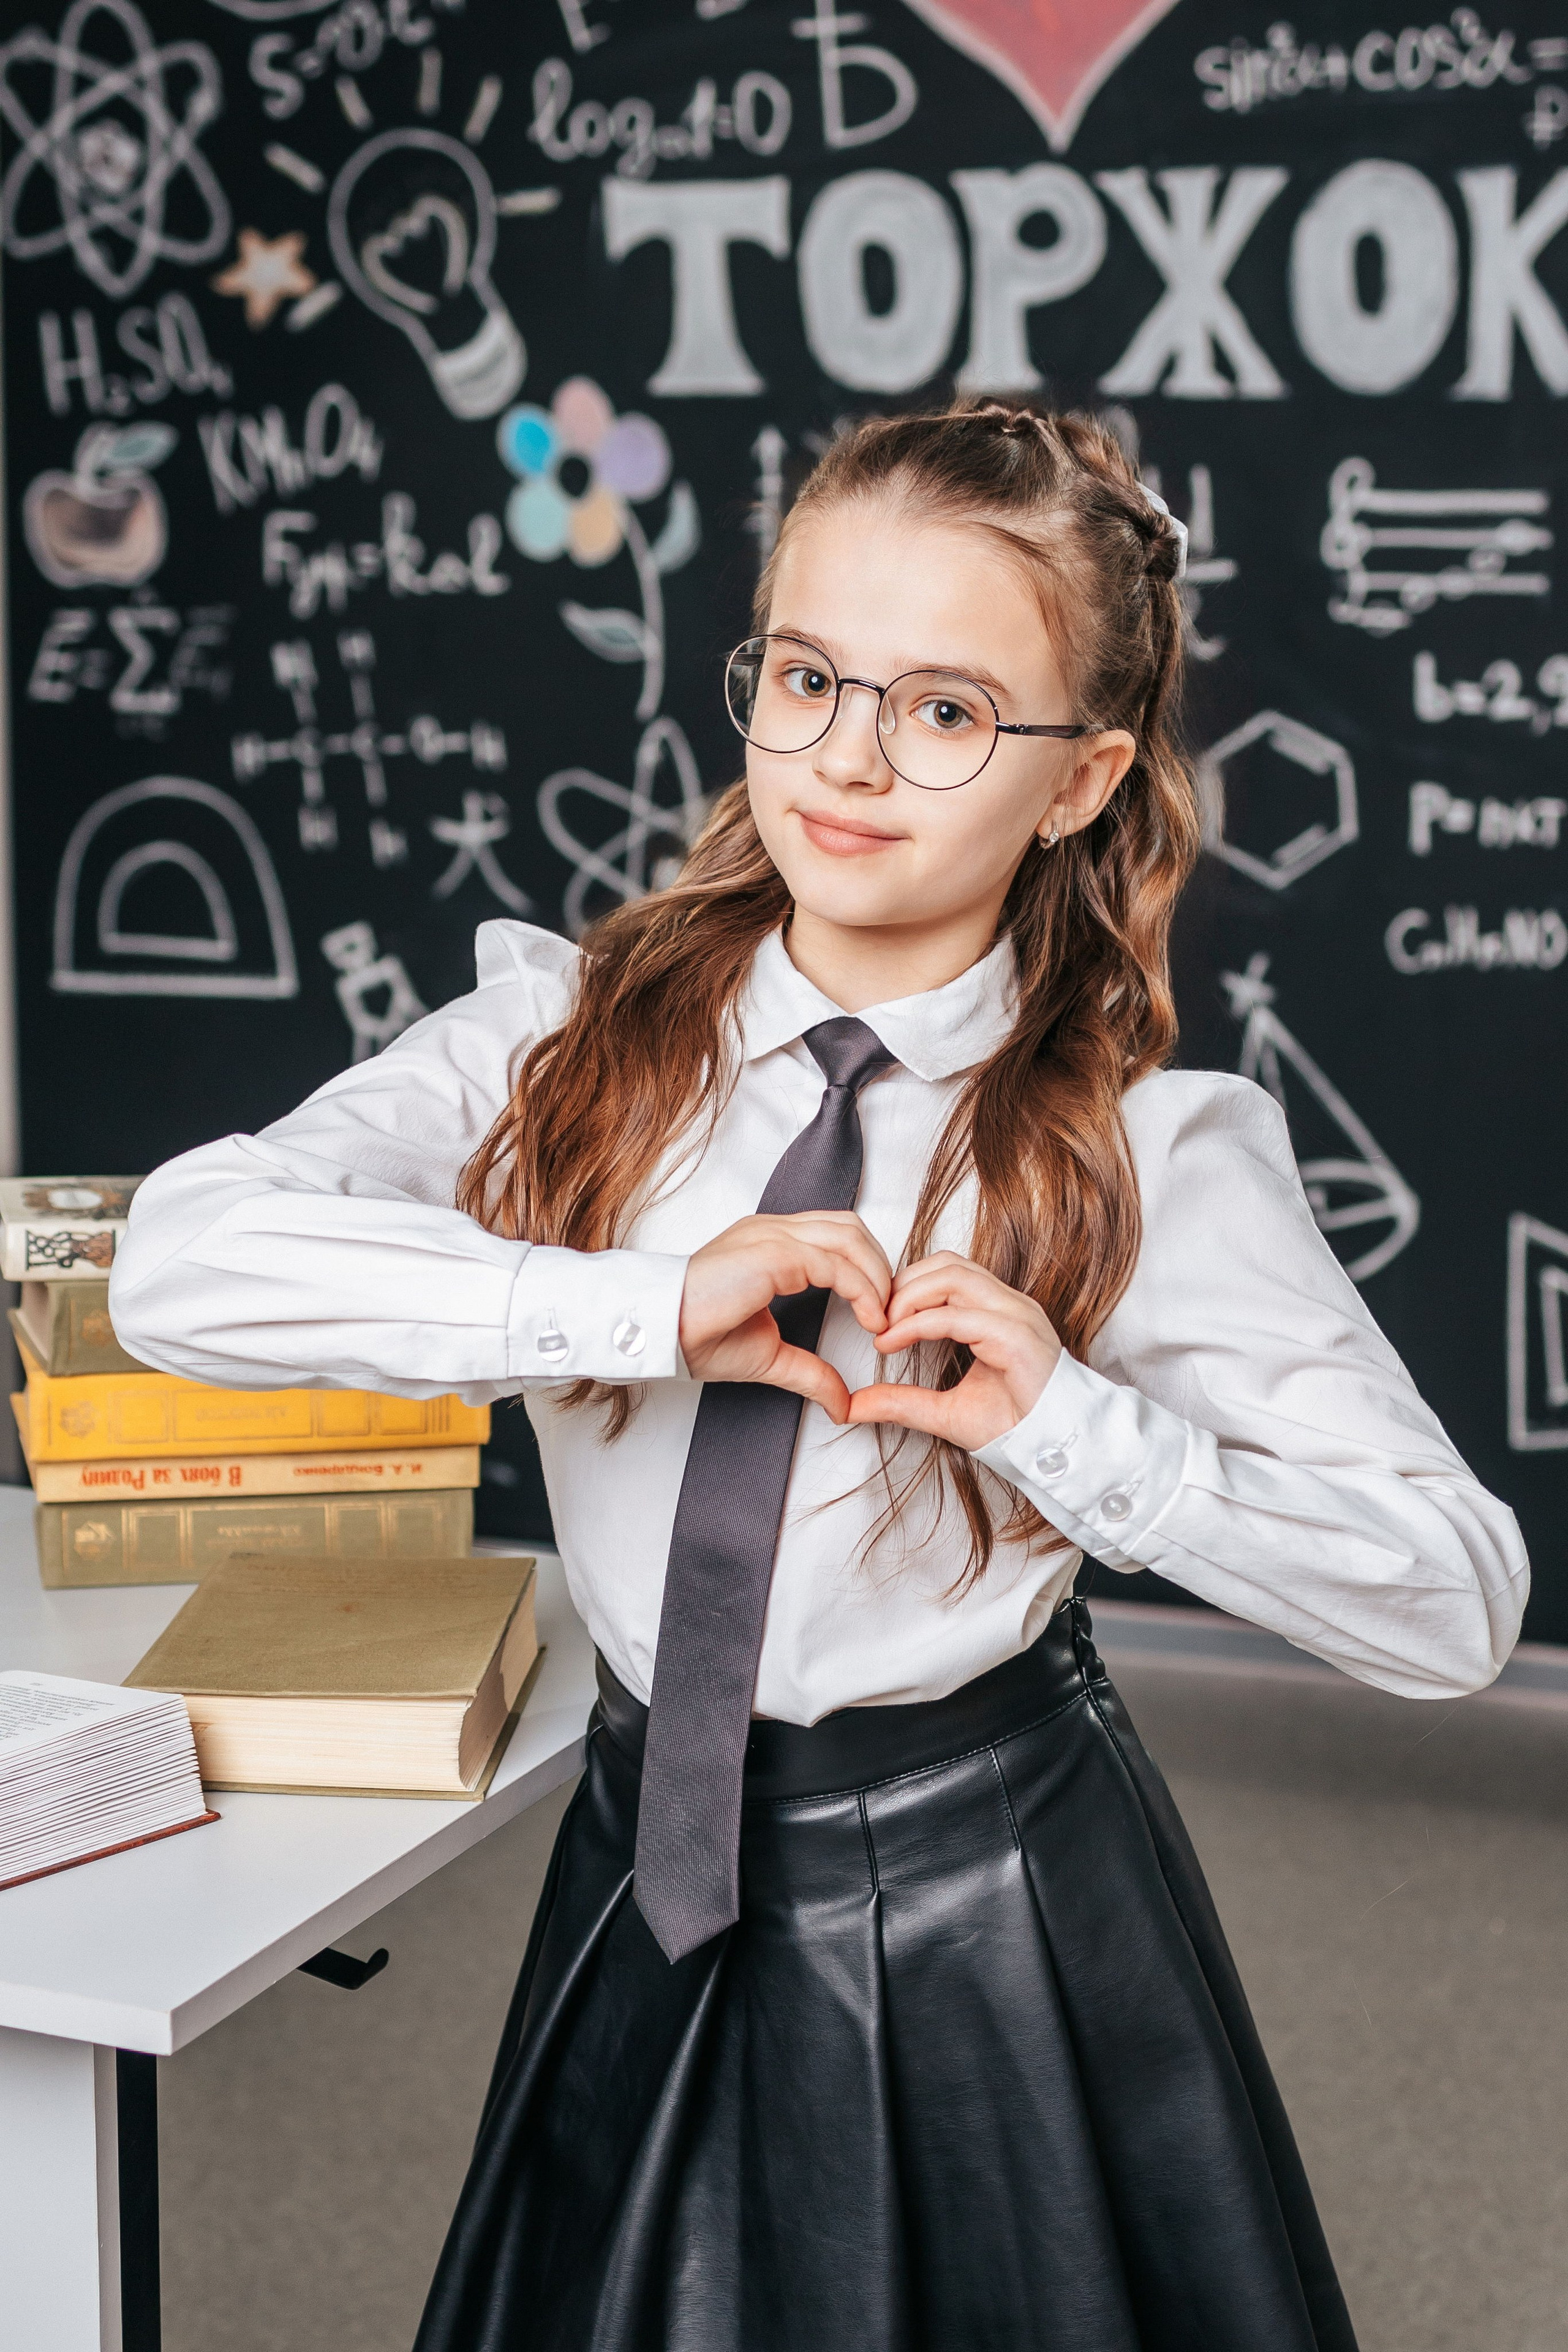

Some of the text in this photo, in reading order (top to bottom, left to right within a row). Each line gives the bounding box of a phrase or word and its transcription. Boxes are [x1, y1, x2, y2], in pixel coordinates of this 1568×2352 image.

[601, 158, 1568, 402] ТОРЖОК
[82, 1466, 242, 1490] В боях за Родину
